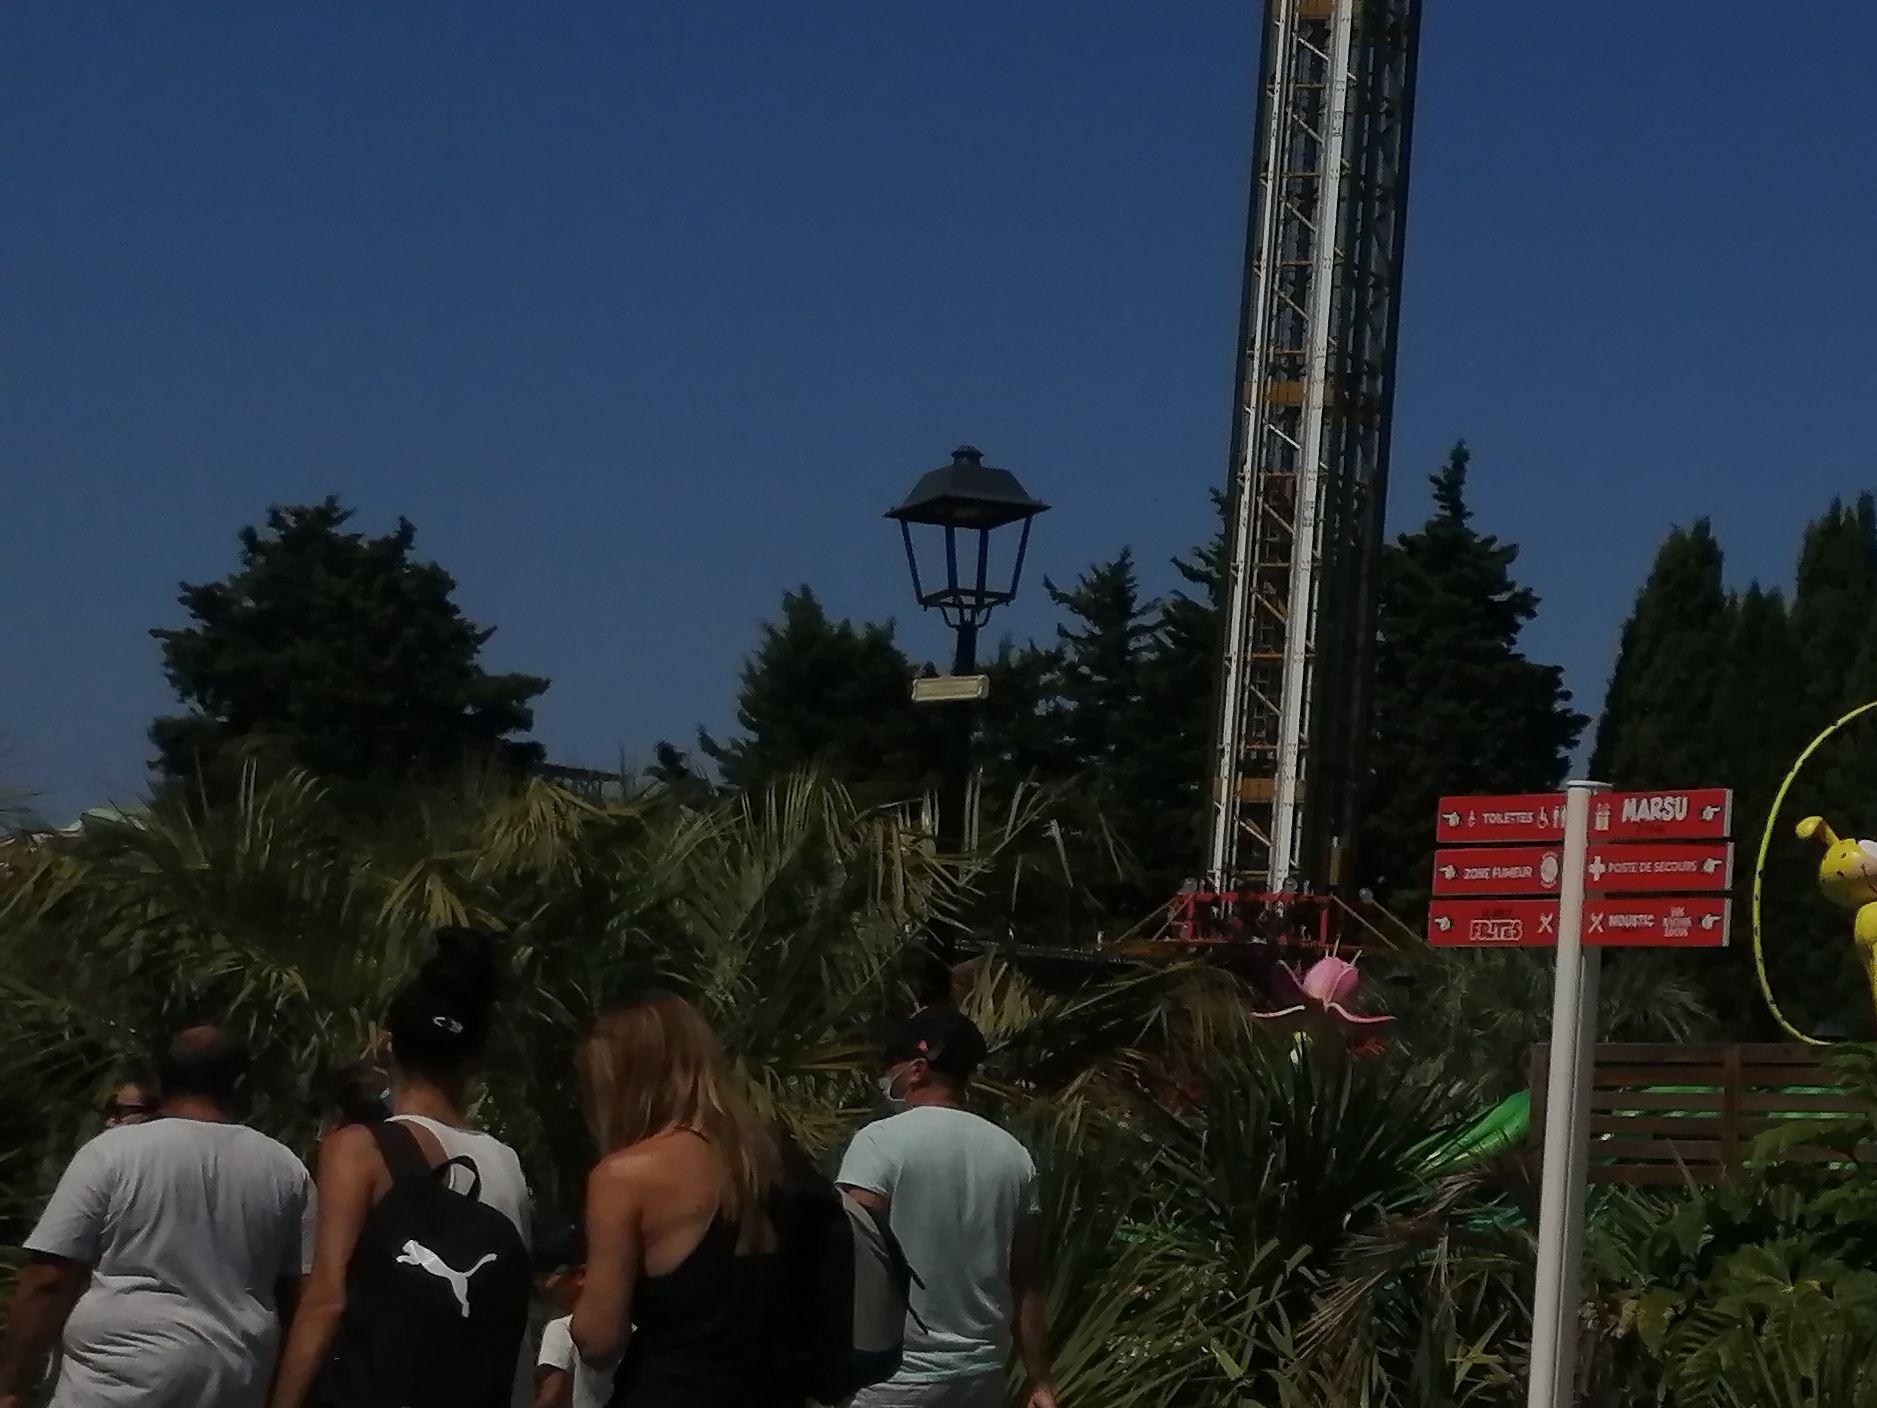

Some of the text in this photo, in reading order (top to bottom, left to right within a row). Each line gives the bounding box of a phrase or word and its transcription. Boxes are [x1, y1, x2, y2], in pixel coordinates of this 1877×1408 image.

[1621, 795, 1689, 824] MARSU
[1481, 811, 1535, 824] TOILETTES
[1492, 865, 1533, 879] FUMEUR
[1639, 861, 1652, 873] DE
[1654, 860, 1699, 873] SECOURS
